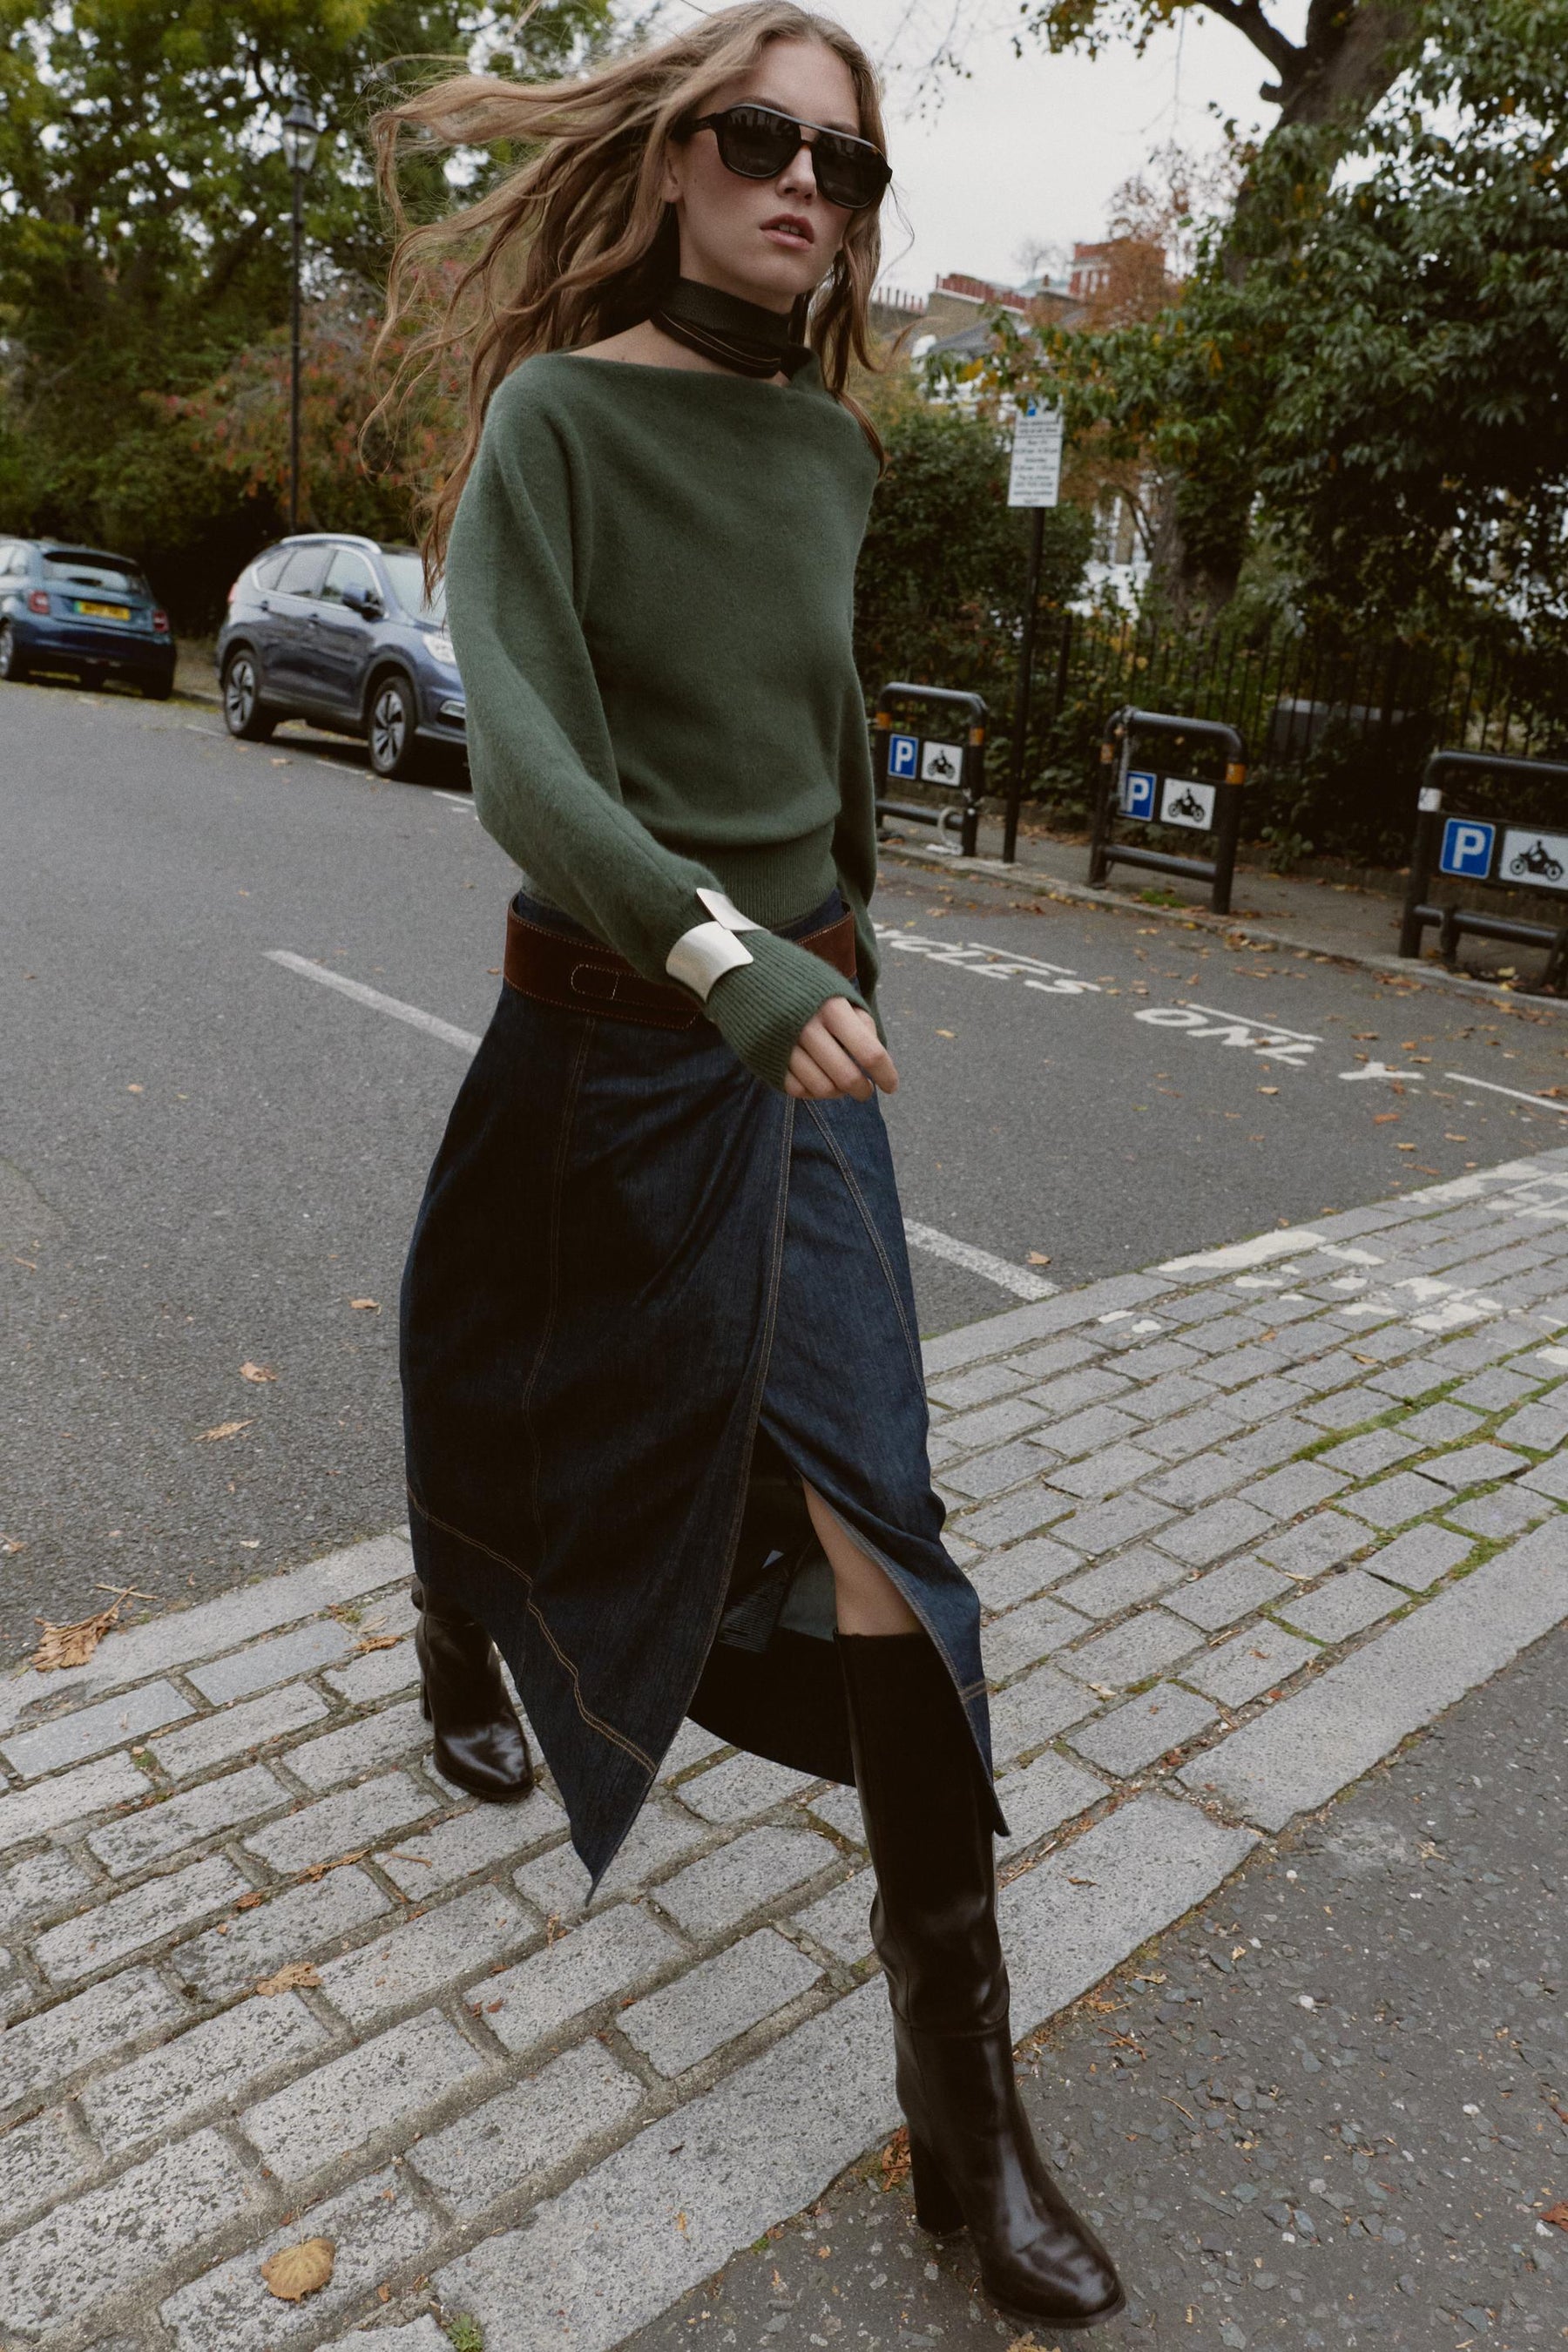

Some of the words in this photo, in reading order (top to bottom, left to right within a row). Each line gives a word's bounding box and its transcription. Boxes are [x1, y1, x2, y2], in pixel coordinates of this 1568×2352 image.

[895, 740, 913, 772] P
[1126, 776, 1149, 812] P
[1452, 827, 1486, 869] P
[872, 923, 1102, 995] YCLES
[1133, 1008, 1425, 1080] ONLY
